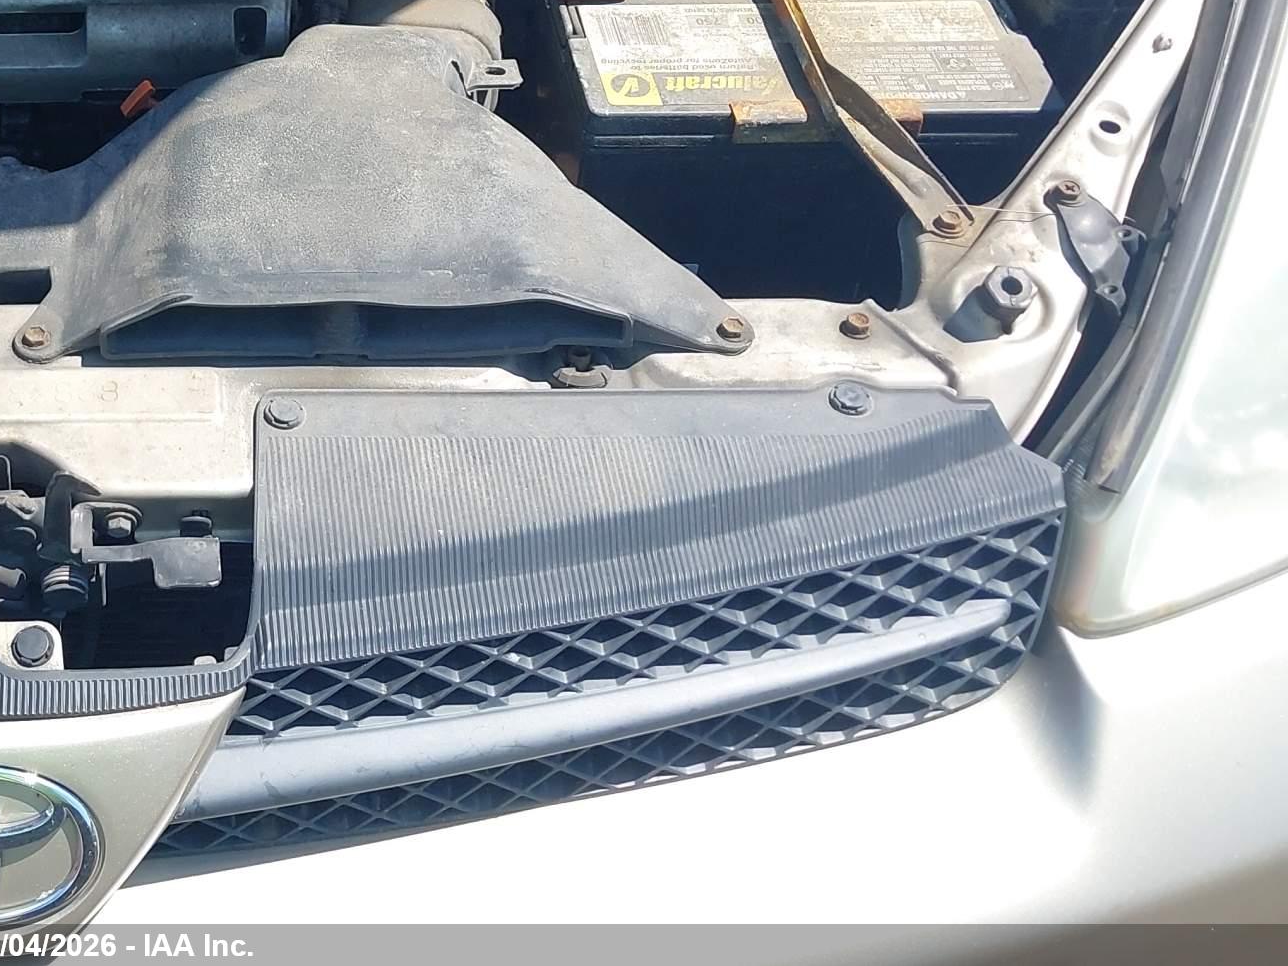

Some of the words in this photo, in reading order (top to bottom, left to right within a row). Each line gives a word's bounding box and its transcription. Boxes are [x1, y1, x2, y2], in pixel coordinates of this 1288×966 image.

[599, 56, 648, 65] recycling
[649, 56, 683, 65] proper
[683, 57, 700, 65] for
[700, 57, 752, 65] AutoZone
[719, 63, 755, 71] Return
[662, 75, 779, 96] Valucraft
